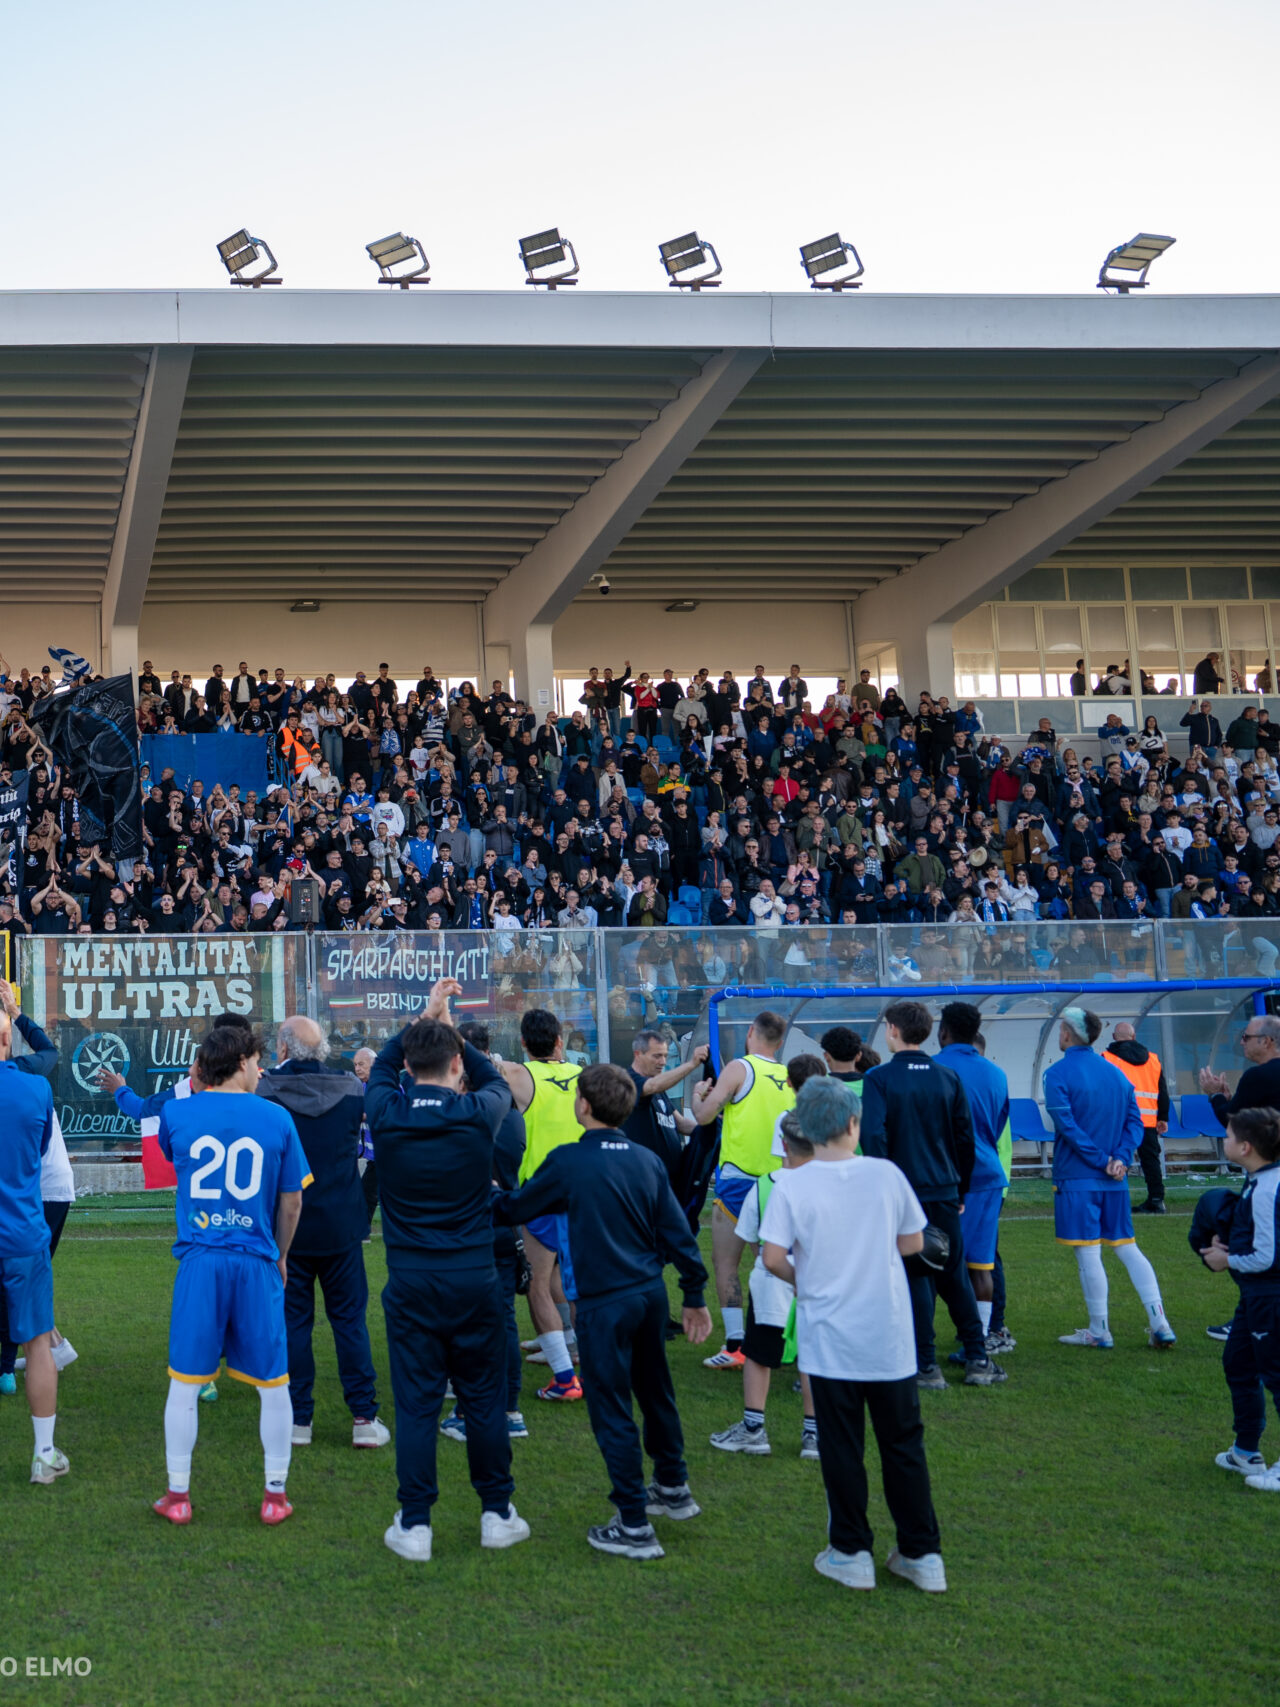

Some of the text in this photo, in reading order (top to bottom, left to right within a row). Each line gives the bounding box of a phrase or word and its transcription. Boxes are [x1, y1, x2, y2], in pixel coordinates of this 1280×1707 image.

[327, 947, 489, 982] SPARPAGGHIATI
[62, 978, 254, 1019] ULTRAS
[151, 1028, 202, 1067] Ultr
[189, 1134, 264, 1201] 20
